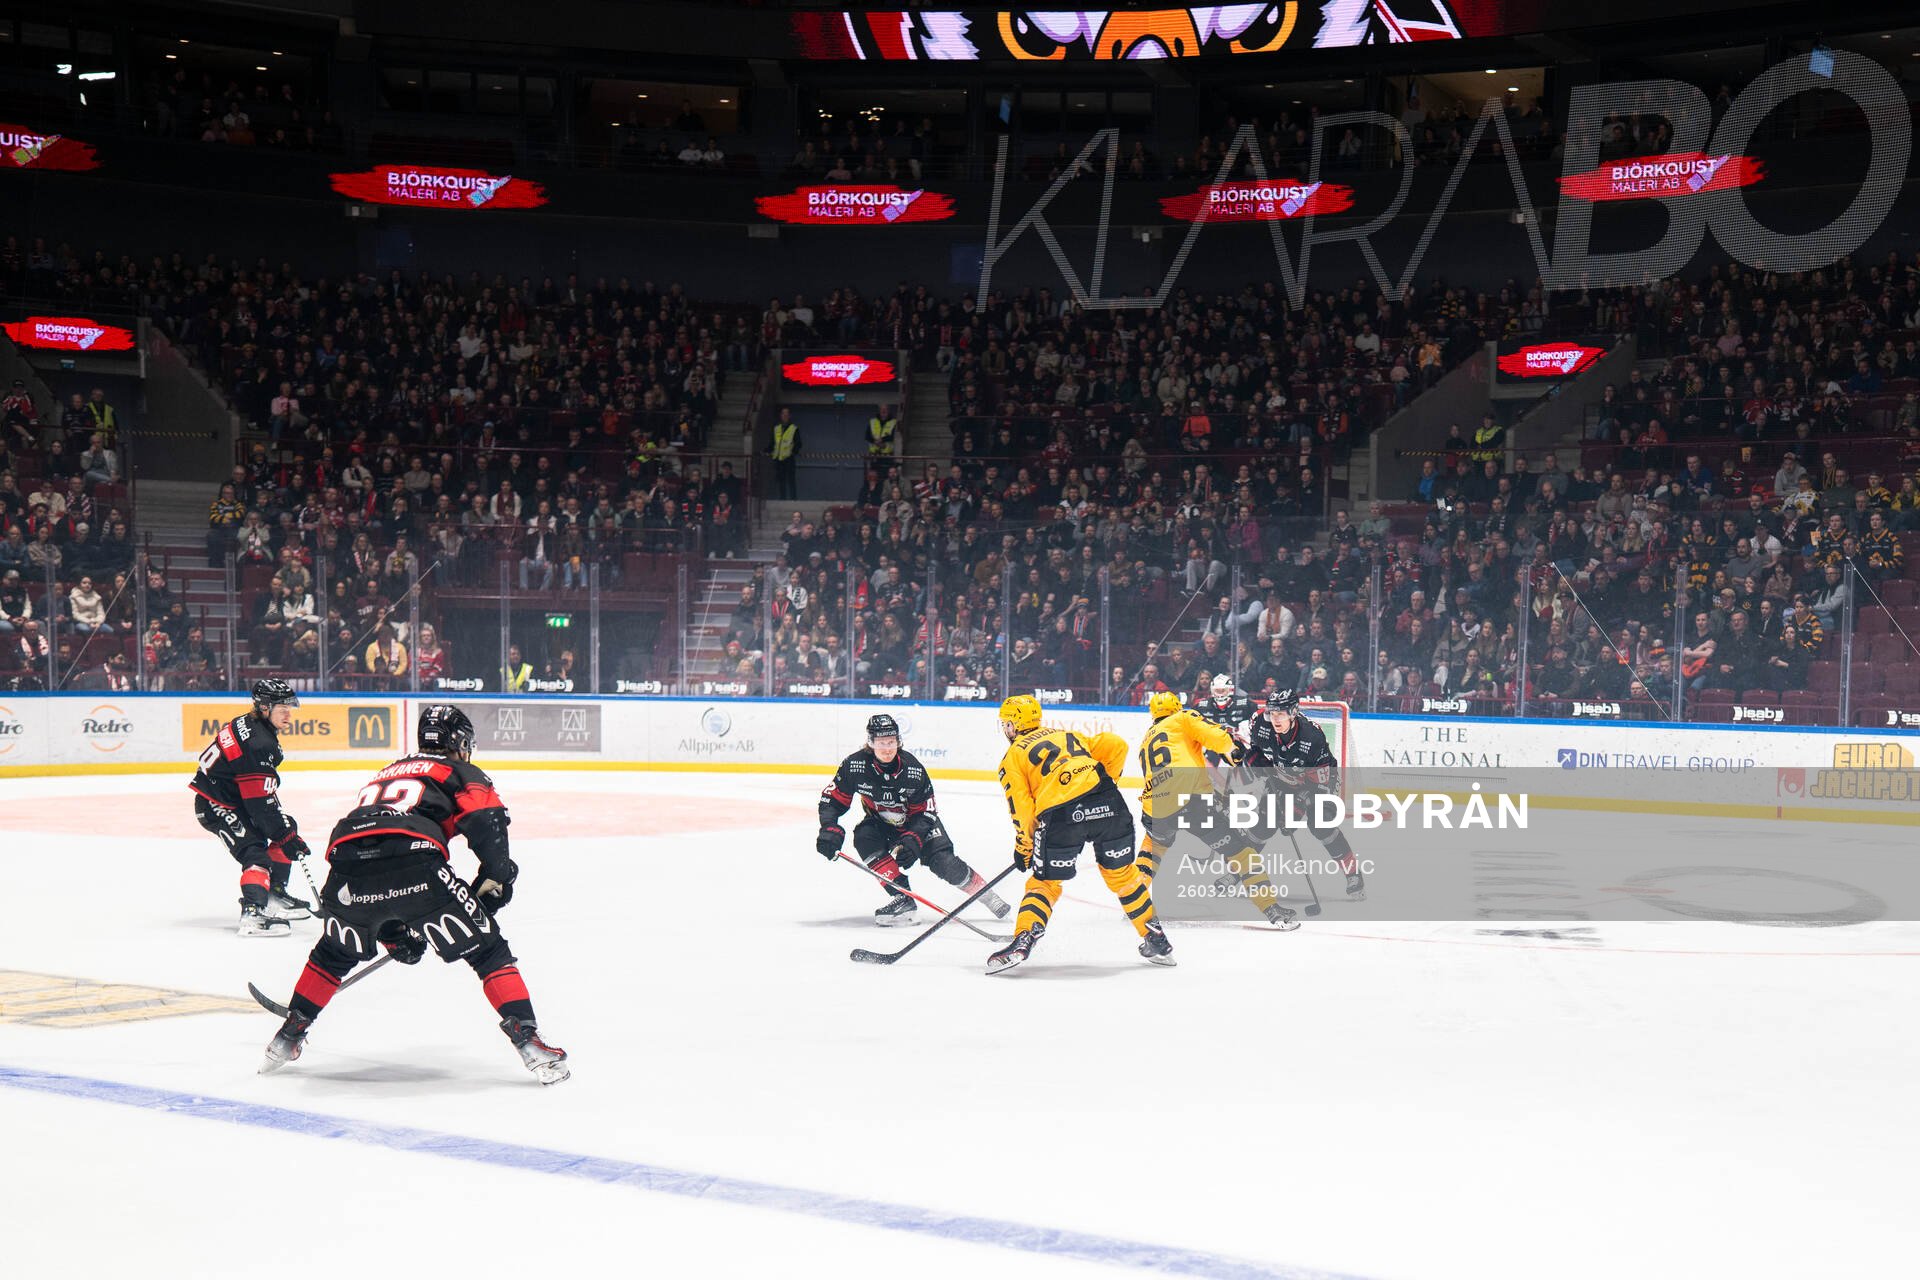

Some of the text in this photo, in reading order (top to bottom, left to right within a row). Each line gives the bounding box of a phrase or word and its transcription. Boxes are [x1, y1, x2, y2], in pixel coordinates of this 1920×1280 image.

[1611, 159, 1717, 180] BJÖRKQUIST
[387, 171, 498, 190] BJÖRKQUIST
[1662, 178, 1681, 190] AB
[388, 187, 460, 201] MÅLERI AB
[808, 190, 911, 206] BJÖRKQUIST
[1210, 186, 1310, 202] BJÖRKQUIST
[808, 205, 876, 217] MÅLERI AB
[1210, 202, 1275, 215] MÅLERI AB
[1431, 698, 1460, 711] isab
[1582, 702, 1612, 714] isab
[1743, 706, 1775, 719] isab
[82, 718, 134, 733] Retro
[494, 731, 528, 742] FAIT
[557, 732, 591, 742] FAIT
[1421, 727, 1468, 743] THE
[1028, 732, 1096, 777] 24
[1139, 731, 1172, 778] 16
[1383, 750, 1507, 769] NATIONAL
[1834, 743, 1902, 770] EURO
[1579, 752, 1755, 775] DIN TRAVEL GROUP
